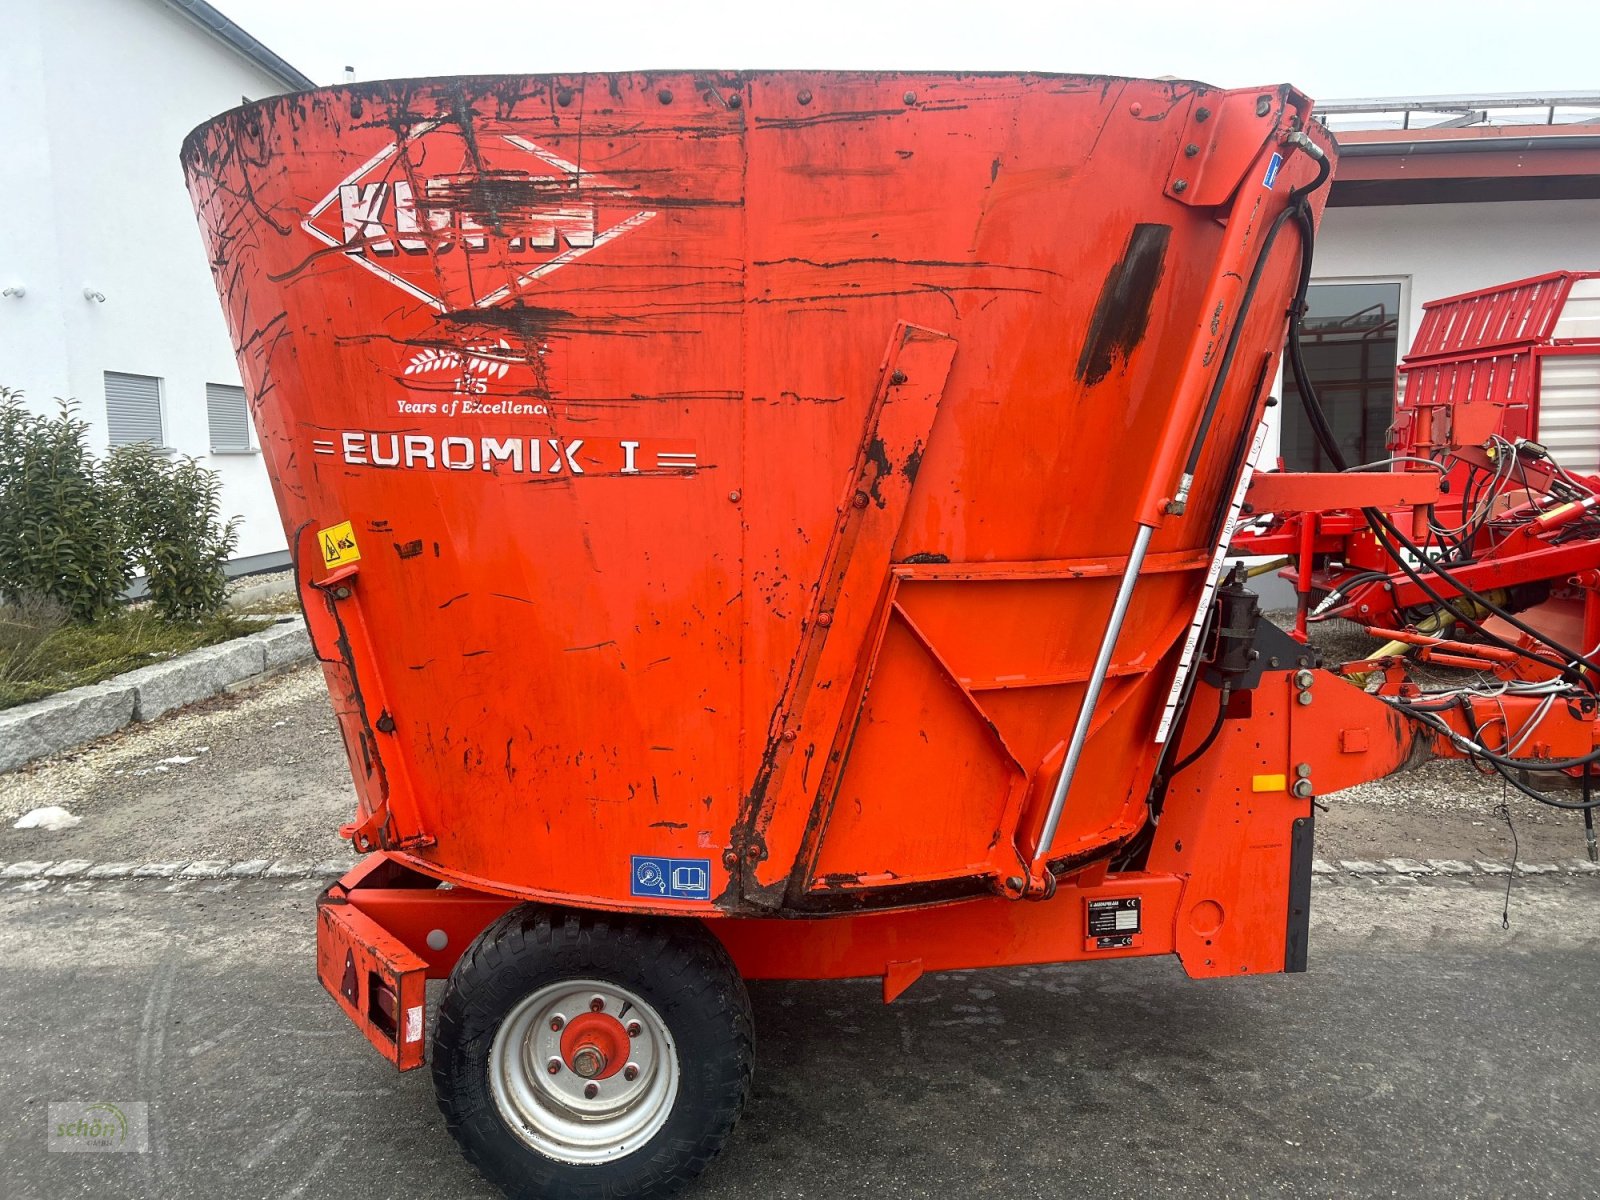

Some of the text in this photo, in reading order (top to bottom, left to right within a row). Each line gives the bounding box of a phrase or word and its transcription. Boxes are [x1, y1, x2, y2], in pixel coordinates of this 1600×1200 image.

[397, 401, 437, 413] Years
[442, 401, 459, 417] of
[341, 432, 640, 474] EUROMIX I
